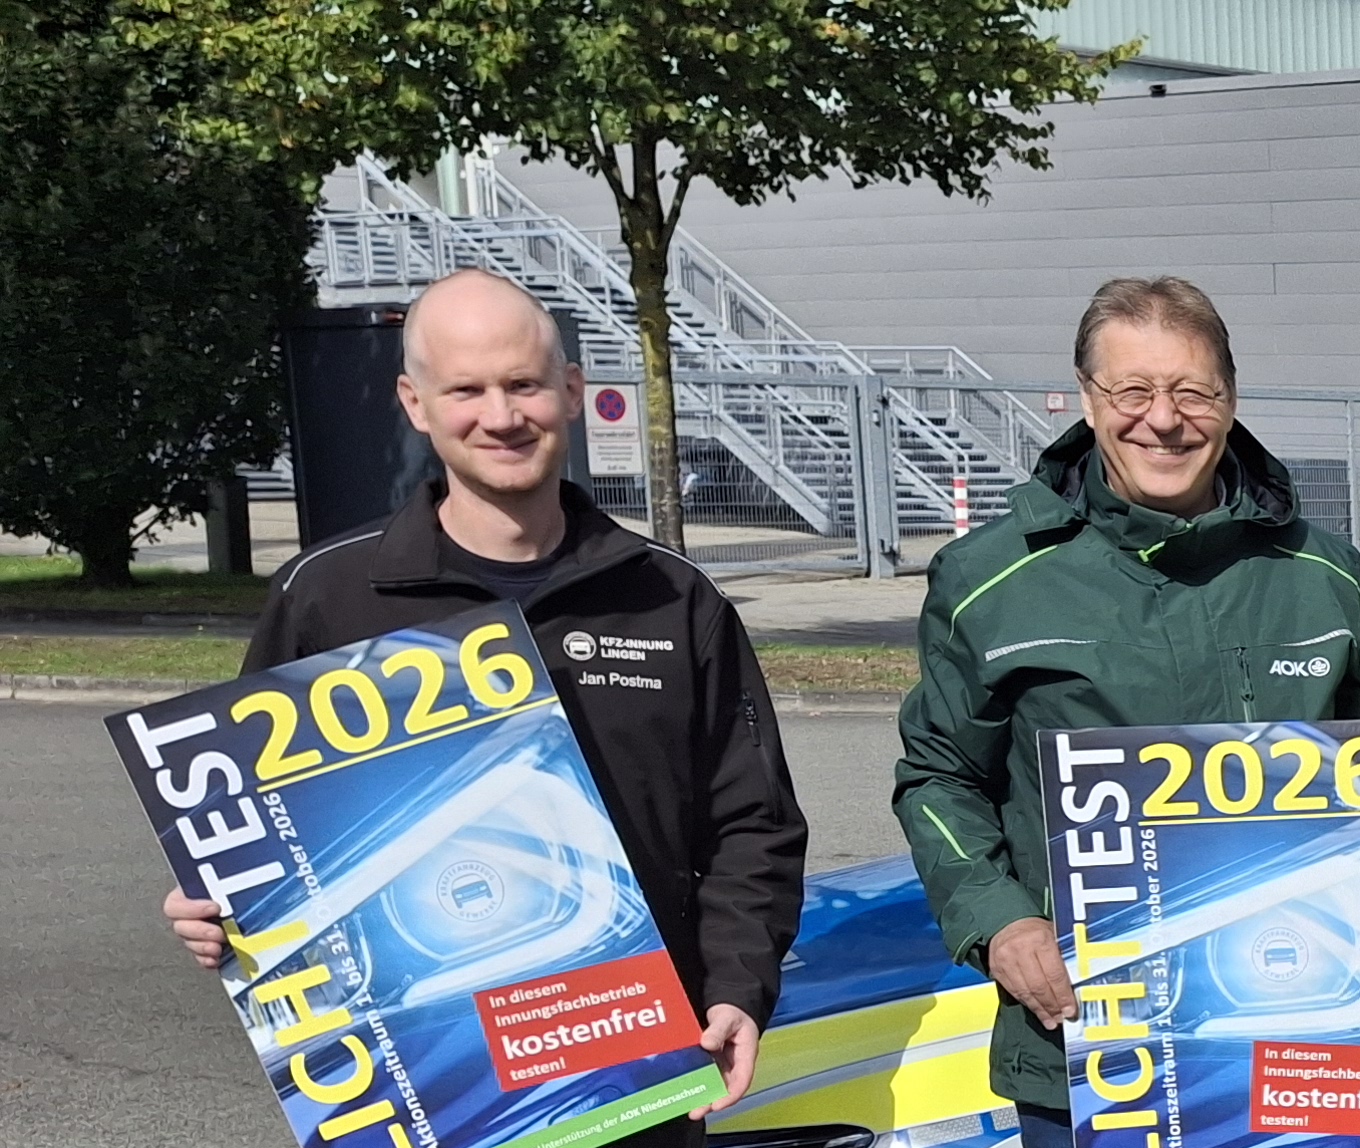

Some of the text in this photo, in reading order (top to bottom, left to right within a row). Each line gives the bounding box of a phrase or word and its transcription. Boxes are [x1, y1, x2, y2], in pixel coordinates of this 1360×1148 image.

[599, 636, 674, 651] KFZ-INNUNG
[600, 647, 646, 661] LINGEN
[578, 671, 662, 690] Jan Postma
[1269, 659, 1310, 677] AOK
[229, 622, 534, 783] 2026
[126, 711, 287, 919] TEST
[263, 792, 297, 841] 2026
[1056, 733, 1138, 921] TEST
[1140, 828, 1158, 872] 2026
[326, 923, 349, 955] 31.
[342, 955, 363, 986] bis
[1152, 952, 1167, 978] 31.
[488, 981, 568, 1009] In diesem
[494, 981, 647, 1028] Innungsfachbetrieb
[1154, 983, 1170, 1007] bis
[501, 999, 667, 1060] kostenfrei
[509, 1056, 567, 1081] testen!
[1264, 1048, 1332, 1061] In diesem
[602, 1114, 620, 1130] der
[619, 1108, 642, 1125] AOK
[640, 1083, 707, 1114] Niedersachsen
[1260, 1114, 1309, 1127] testen!
